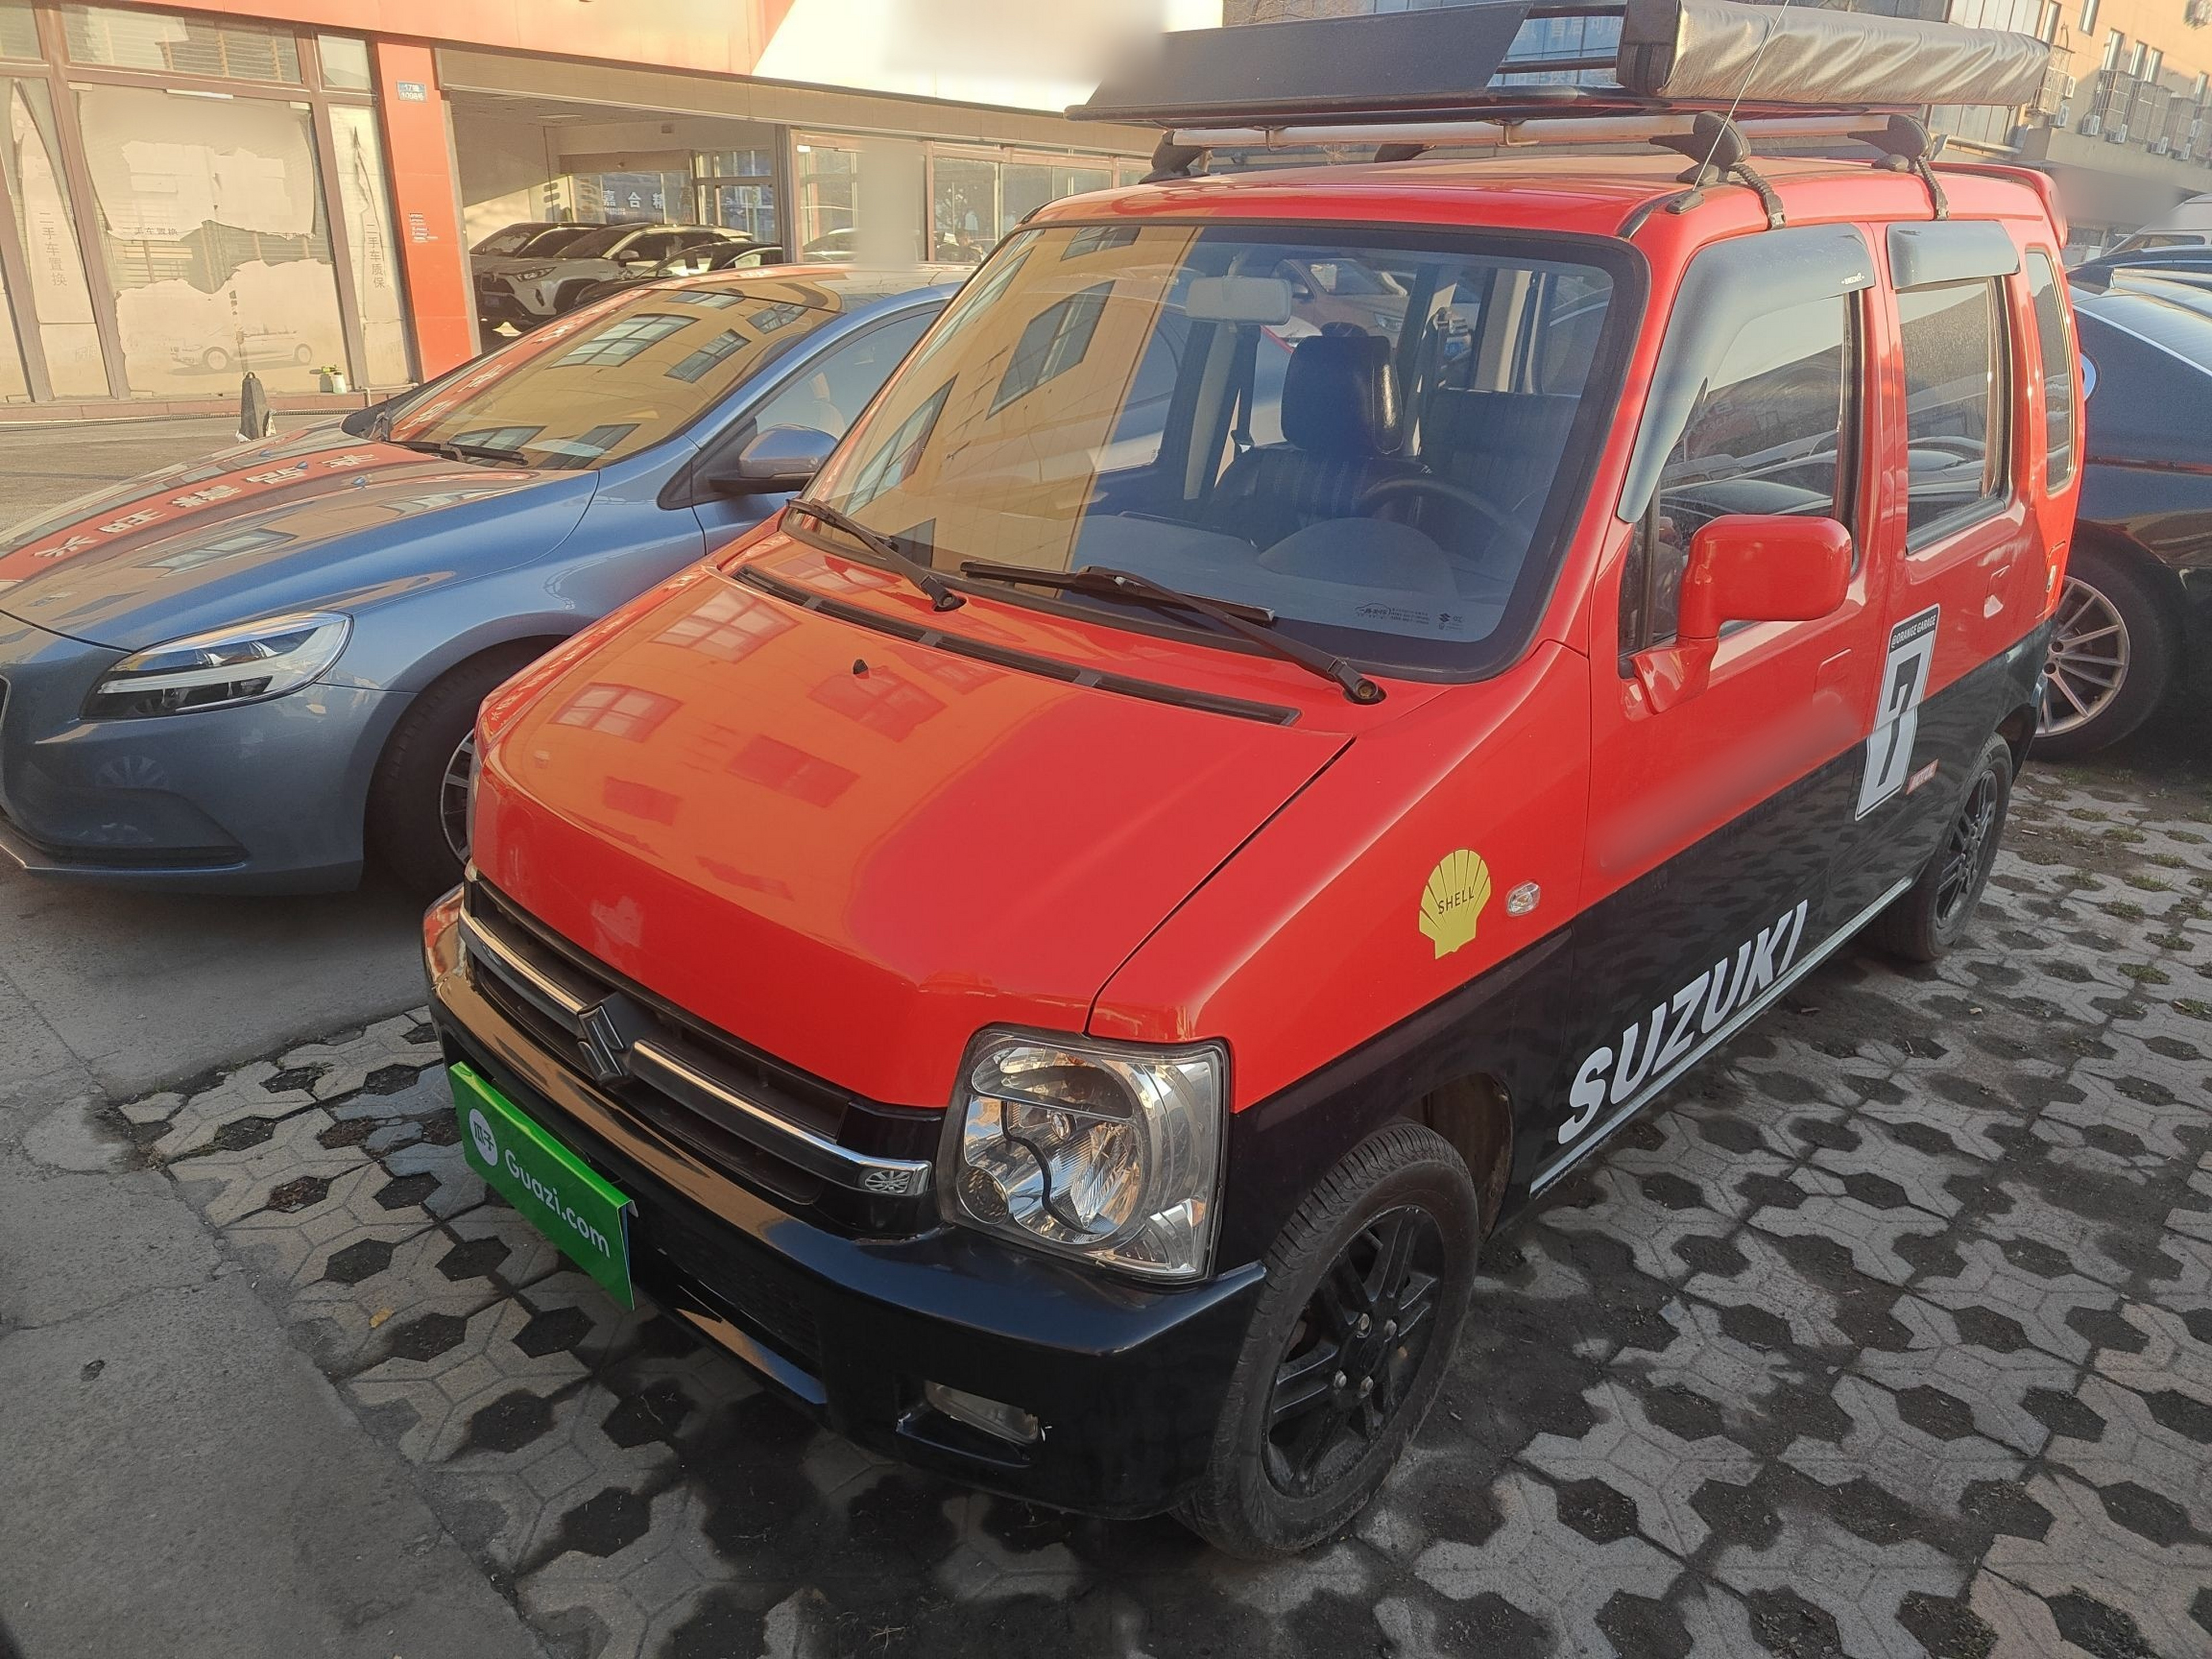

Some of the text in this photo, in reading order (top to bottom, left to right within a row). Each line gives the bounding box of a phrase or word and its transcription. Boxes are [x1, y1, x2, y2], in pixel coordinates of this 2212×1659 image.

[39, 212, 67, 286] 二手车置换
[366, 224, 385, 289] 二手车质保
[1916, 614, 1937, 633] GARAGE
[1438, 886, 1475, 915] SHELL
[1558, 899, 1808, 1144] SUZUKI
[473, 1120, 495, 1152] 瓜子
[505, 1149, 611, 1259] Guazi.com
